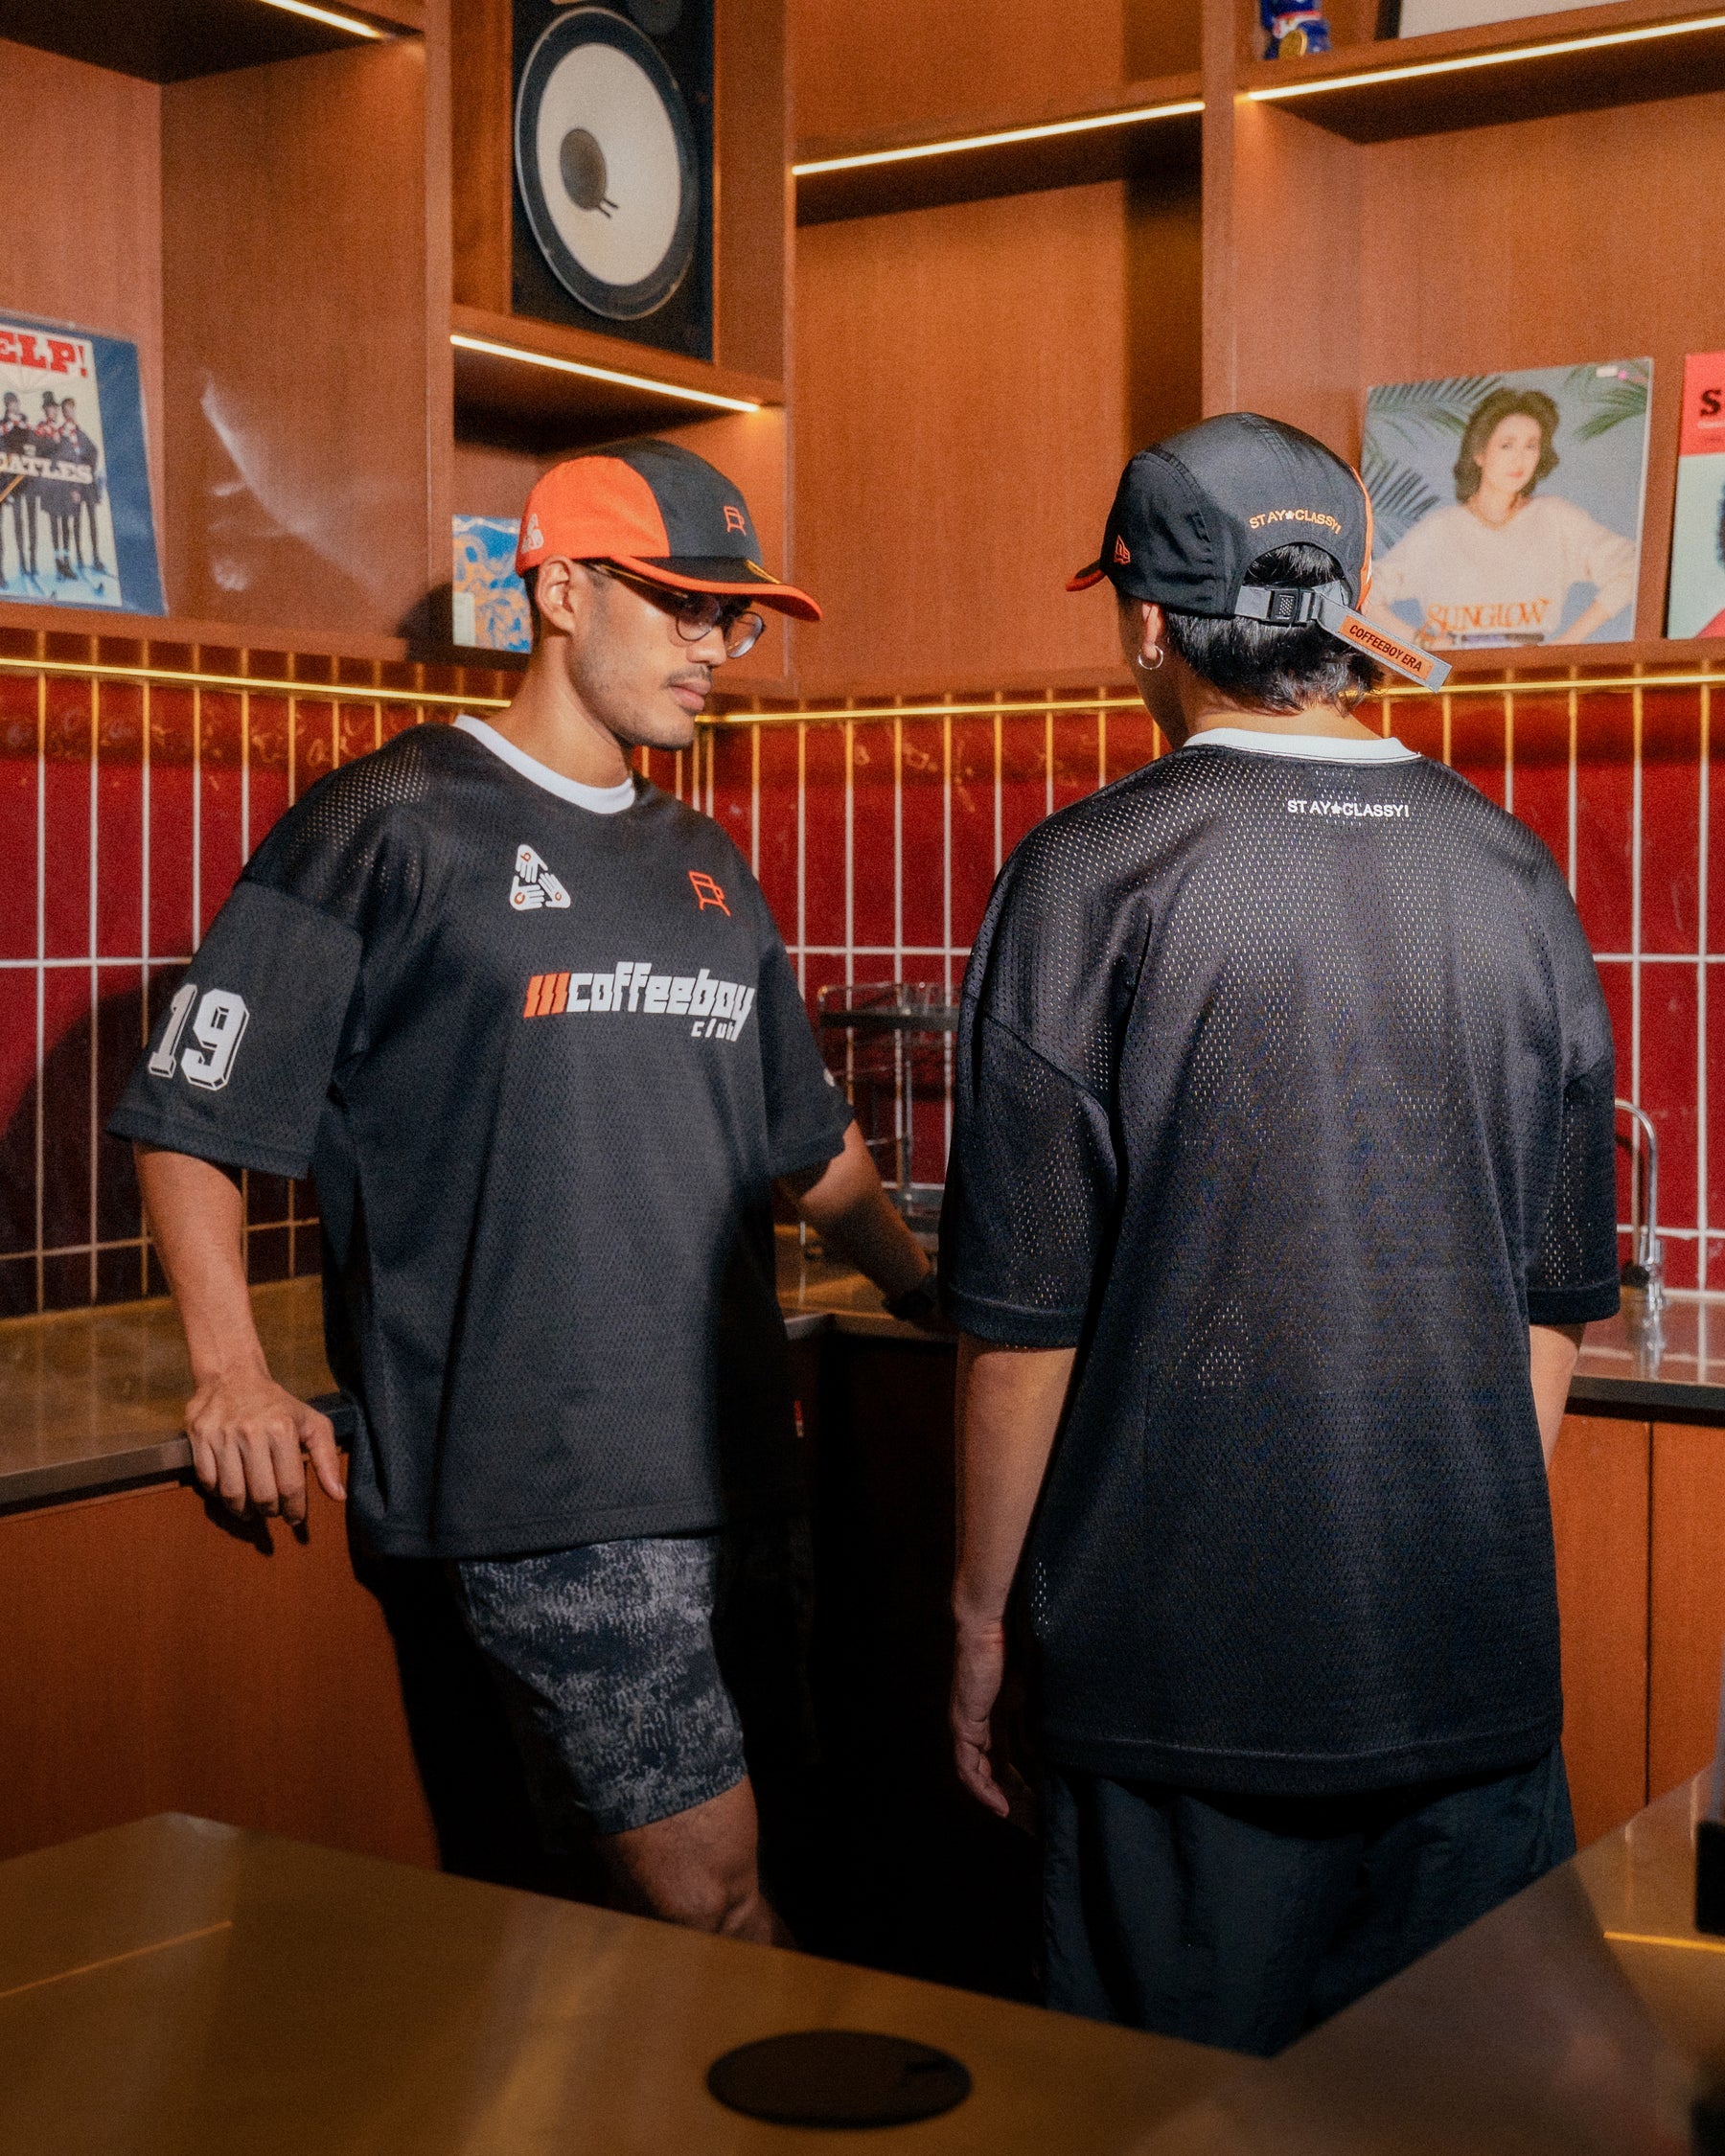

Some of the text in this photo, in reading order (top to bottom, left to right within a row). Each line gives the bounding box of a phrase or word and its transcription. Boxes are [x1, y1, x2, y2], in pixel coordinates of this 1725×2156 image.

[1349, 625, 1422, 672] COFFEEBOY ERA
[148, 983, 250, 1091] 19
[565, 961, 756, 1043] coffeeboy
